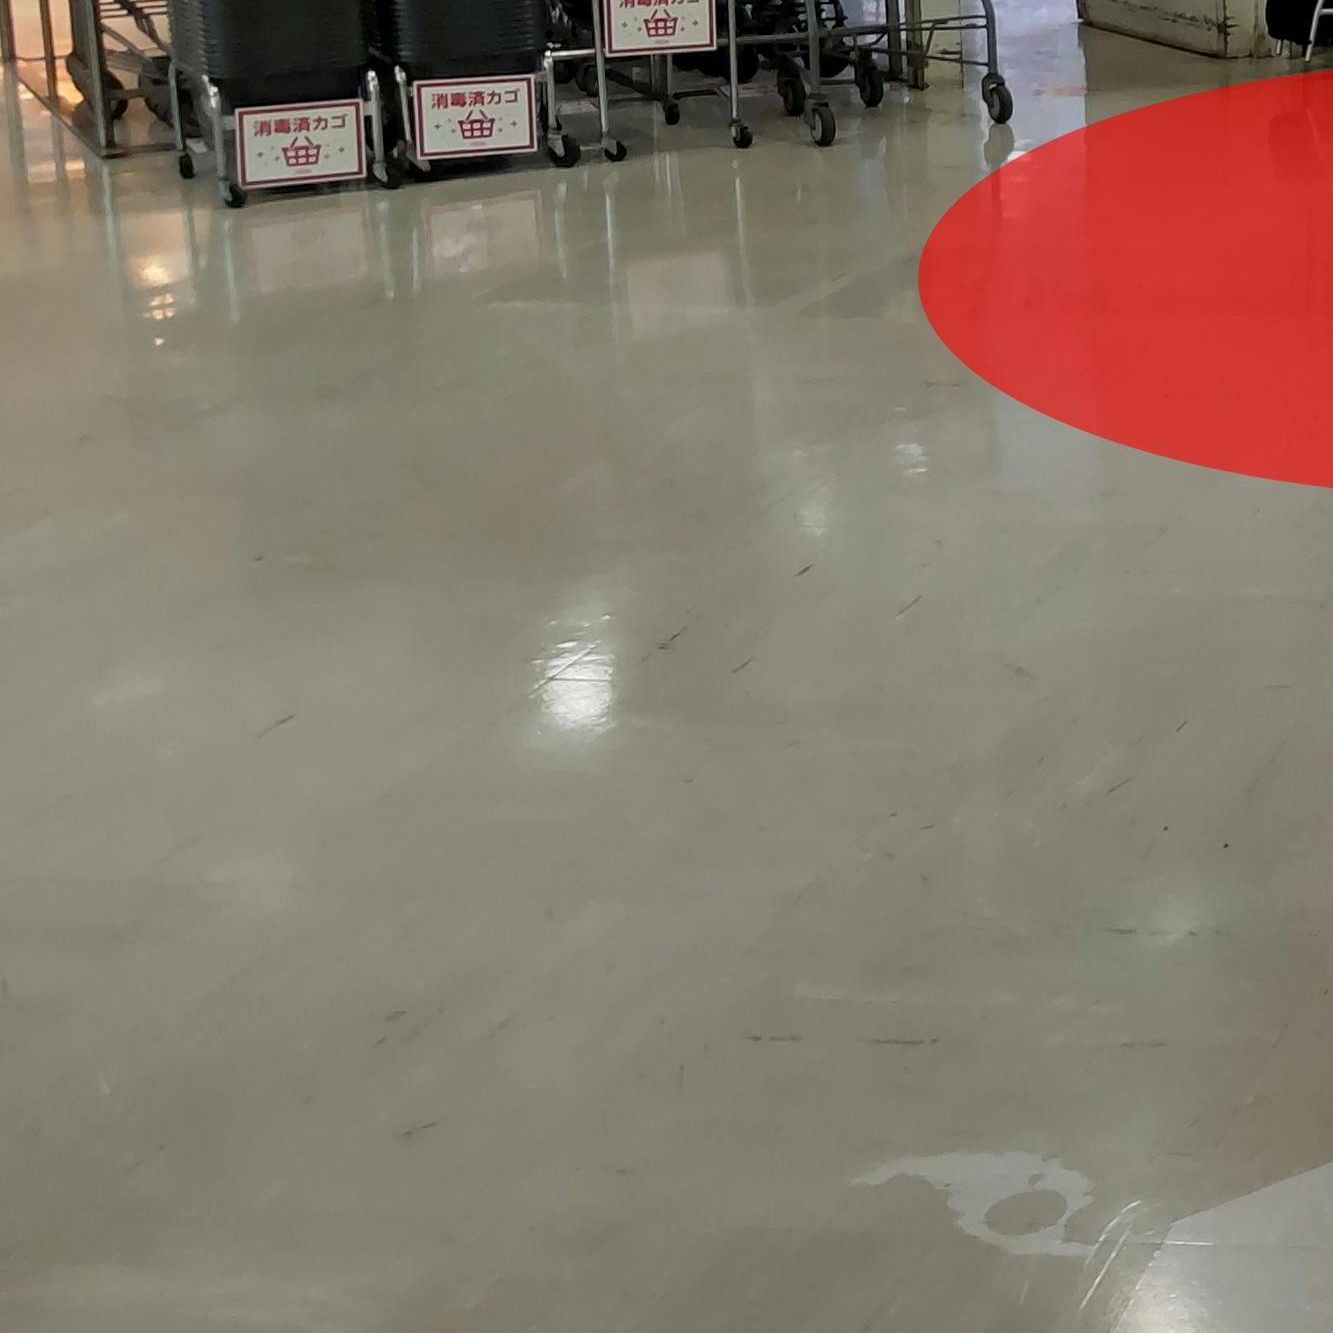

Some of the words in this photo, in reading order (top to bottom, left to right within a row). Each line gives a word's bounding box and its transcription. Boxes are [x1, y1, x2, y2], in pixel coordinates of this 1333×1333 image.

[430, 88, 521, 111] 消毒済カゴ
[252, 113, 349, 138] 消毒済カゴ
